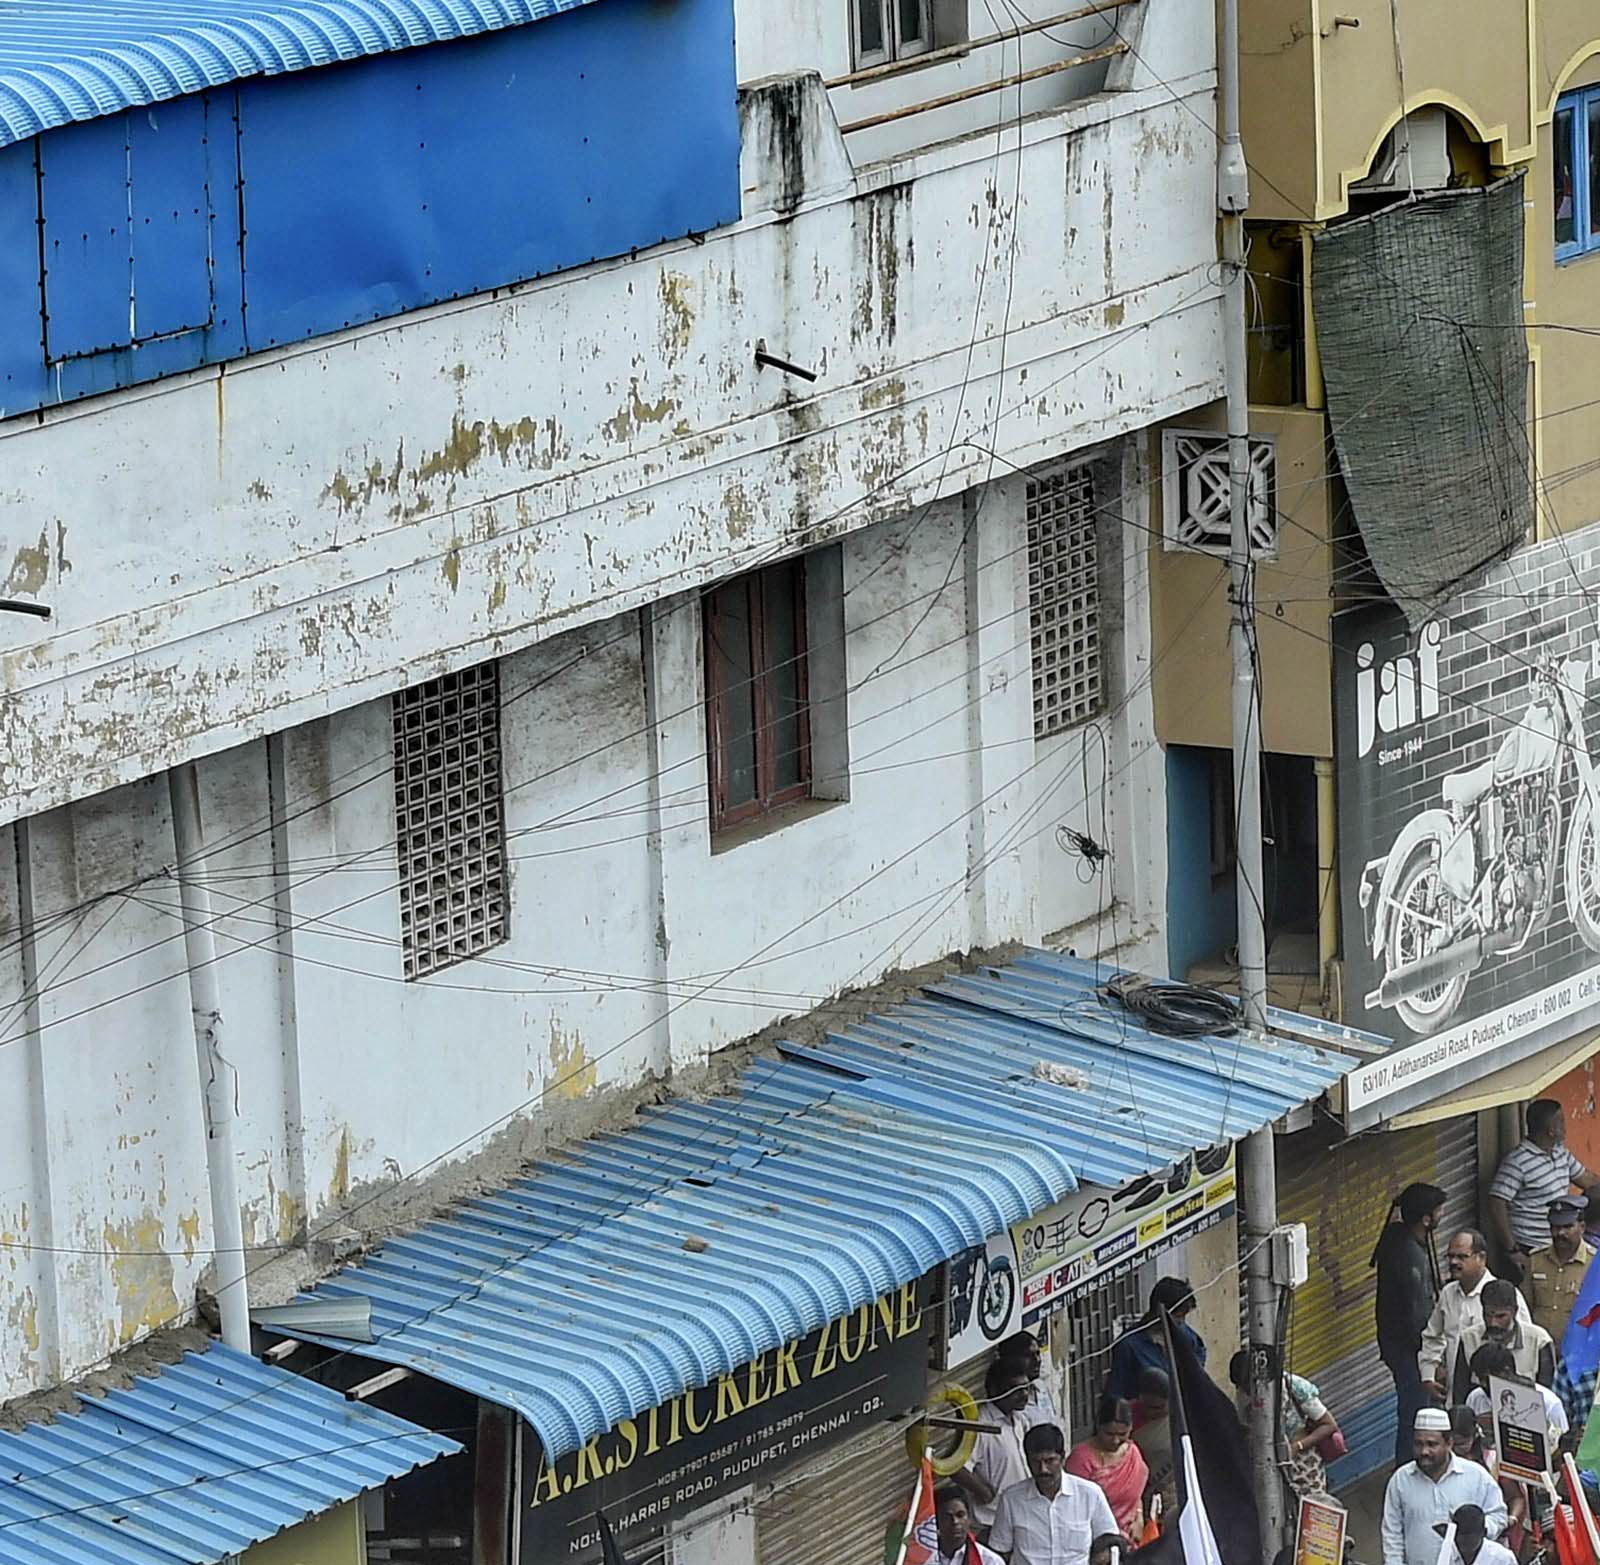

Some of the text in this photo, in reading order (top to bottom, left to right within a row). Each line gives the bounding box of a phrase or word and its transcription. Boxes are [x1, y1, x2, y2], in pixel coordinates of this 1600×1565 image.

[1356, 620, 1442, 760] jaf
[1378, 746, 1401, 766] Since
[1361, 1068, 1391, 1095] 63/107,
[1448, 1034, 1471, 1058] Road,
[1472, 1023, 1505, 1049] Pudupet,
[1507, 1008, 1538, 1032] Chennai
[1544, 996, 1557, 1013] 600
[1557, 988, 1571, 1006] 002
[810, 1280, 922, 1380] ZONE
[675, 1478, 718, 1504] ROAD,
[722, 1441, 788, 1483] PUDUPET,
[791, 1410, 851, 1450] CHENNAI
[862, 1398, 886, 1416] 02.
